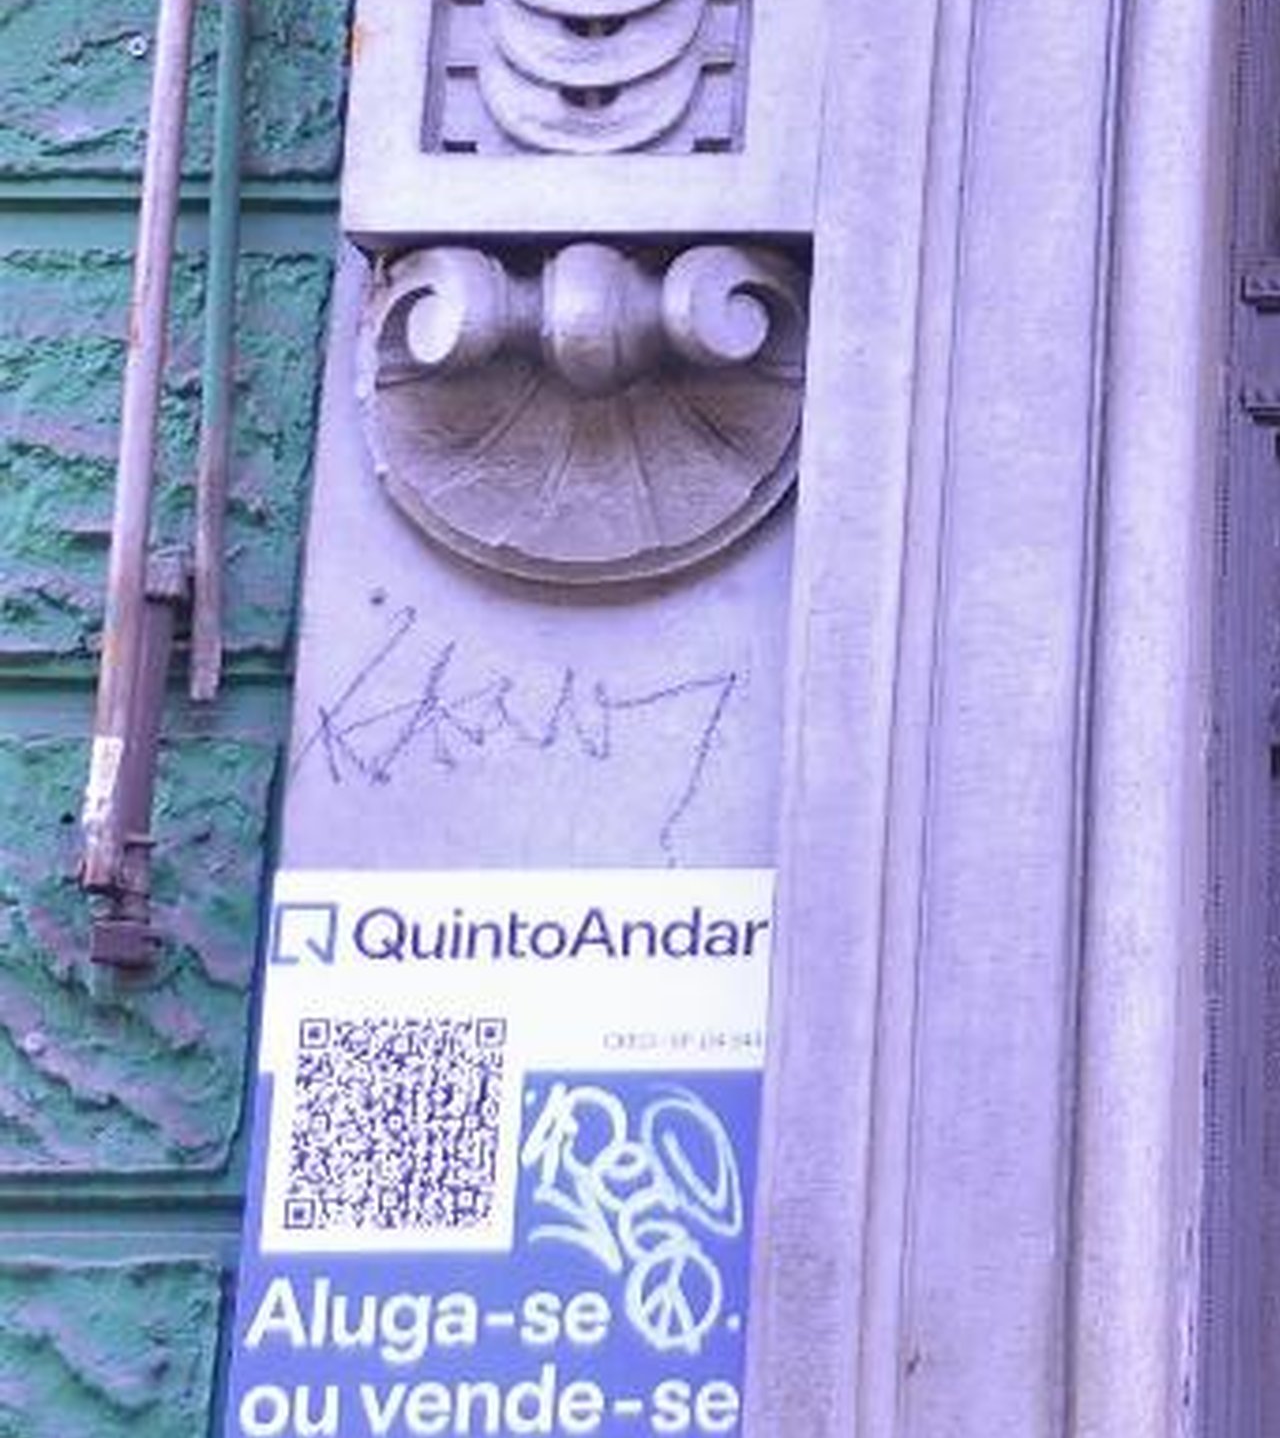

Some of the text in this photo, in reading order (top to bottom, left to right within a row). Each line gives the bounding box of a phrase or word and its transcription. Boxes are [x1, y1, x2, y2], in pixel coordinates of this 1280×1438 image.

[351, 906, 770, 964] QuintoAndar
[242, 1276, 614, 1364] Aluga-se
[361, 1364, 740, 1438] vende-se
